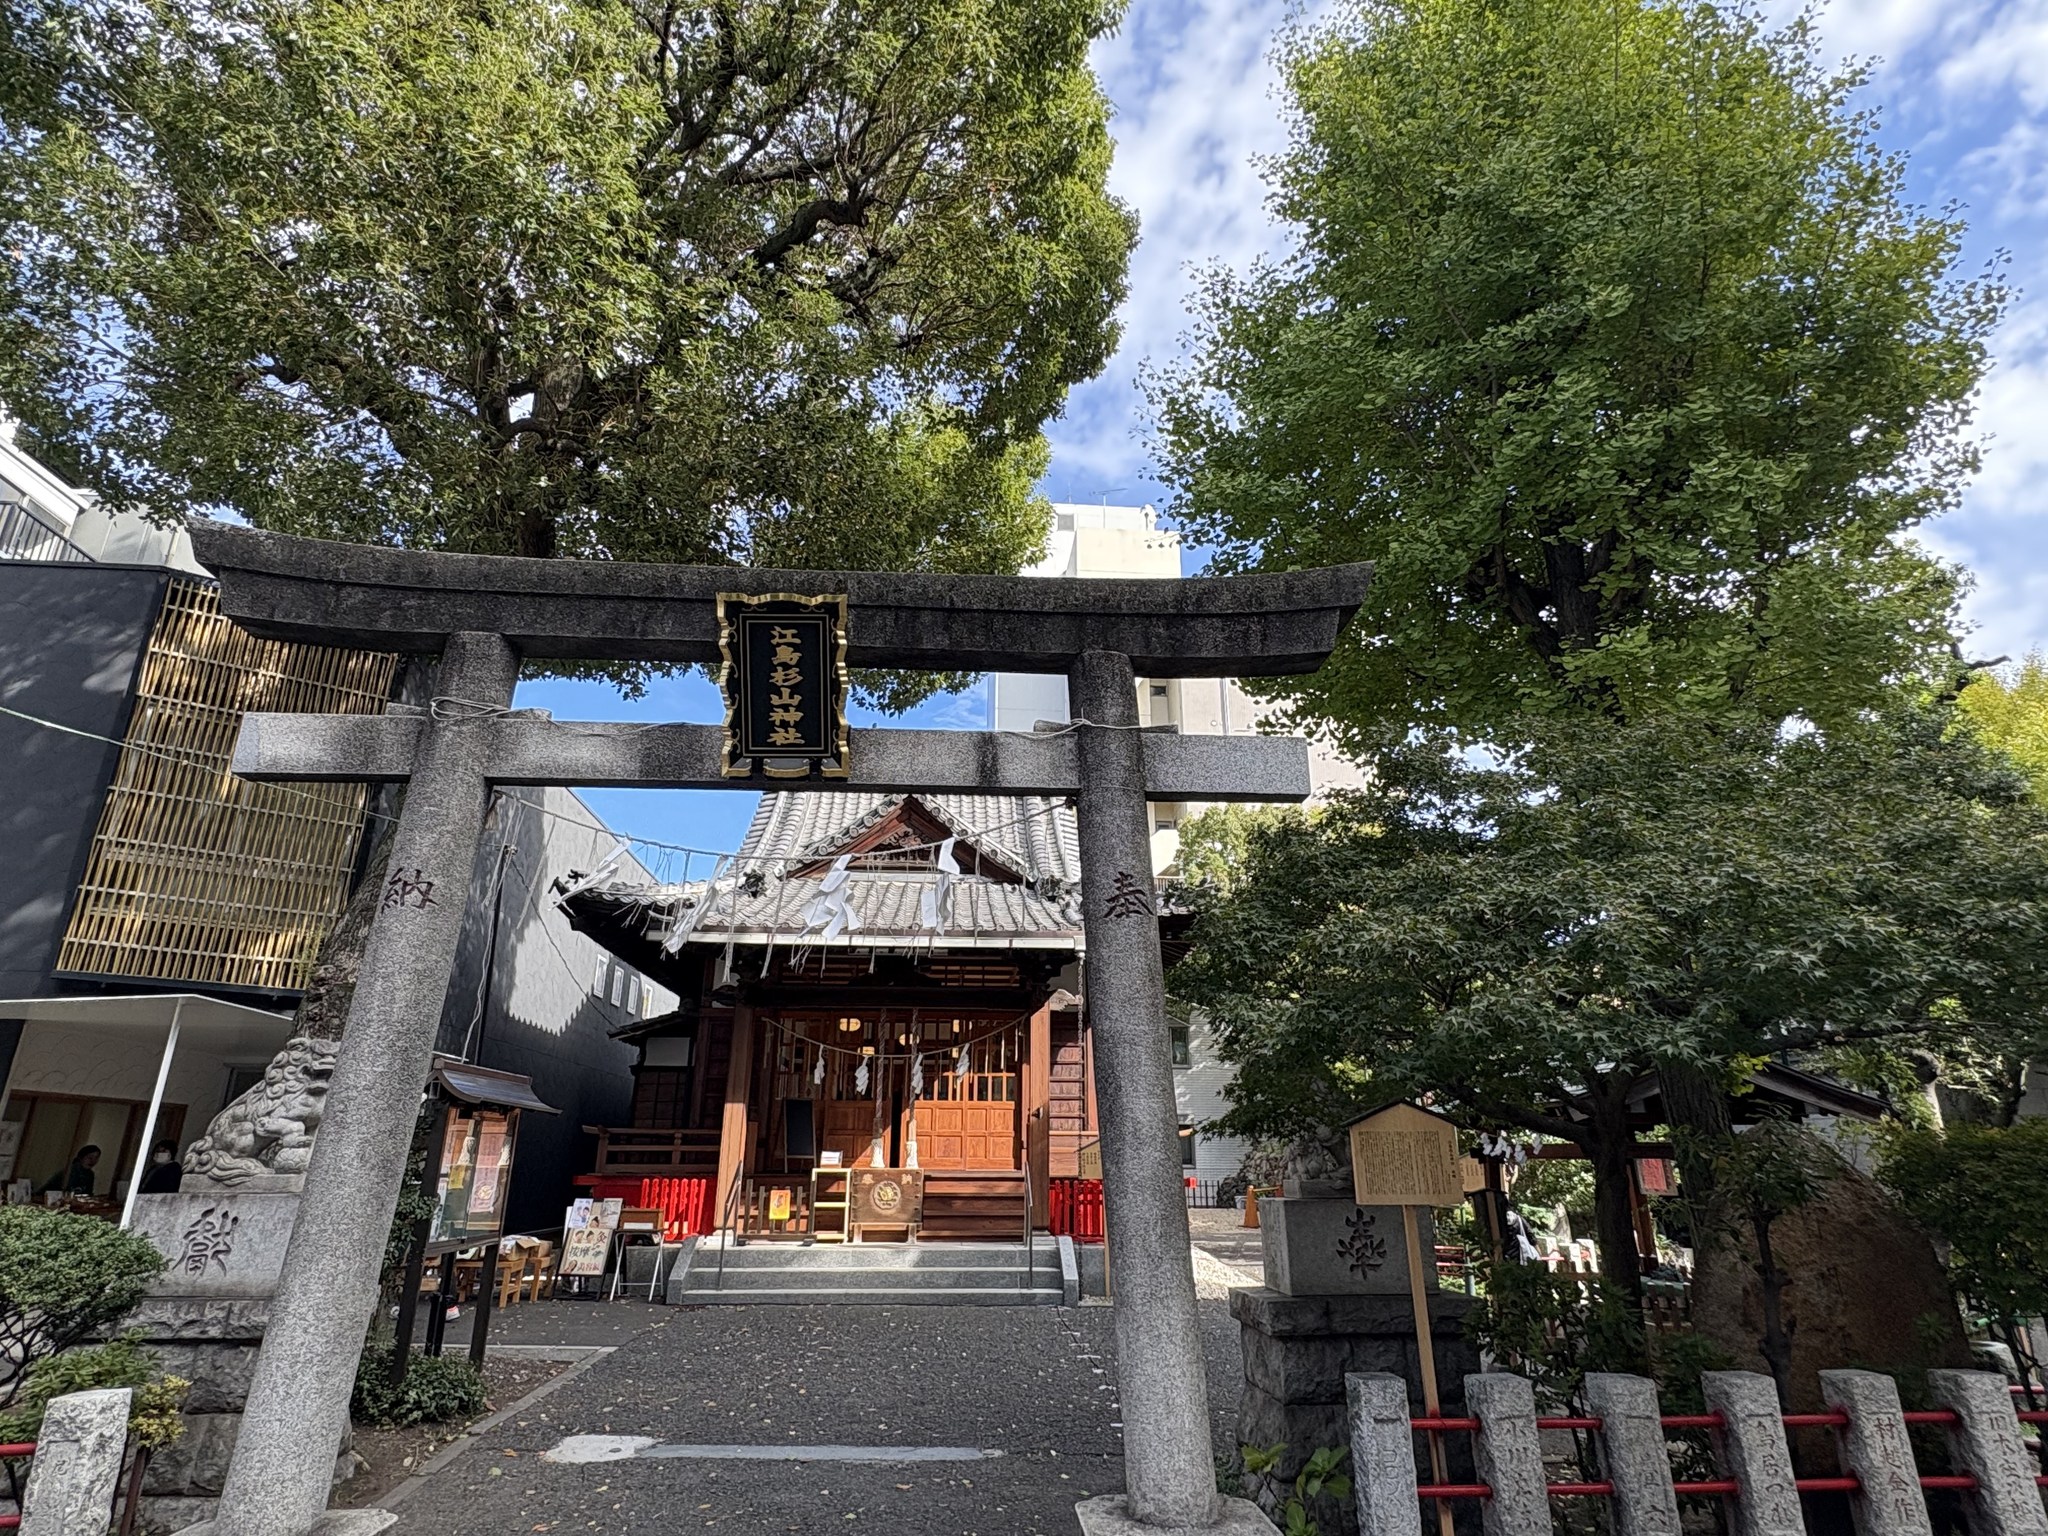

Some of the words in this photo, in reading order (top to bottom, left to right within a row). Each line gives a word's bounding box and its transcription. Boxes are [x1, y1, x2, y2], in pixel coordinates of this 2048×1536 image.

[767, 626, 805, 746] 江島杉山神社
[381, 867, 440, 915] 納
[1103, 871, 1155, 919] 奉
